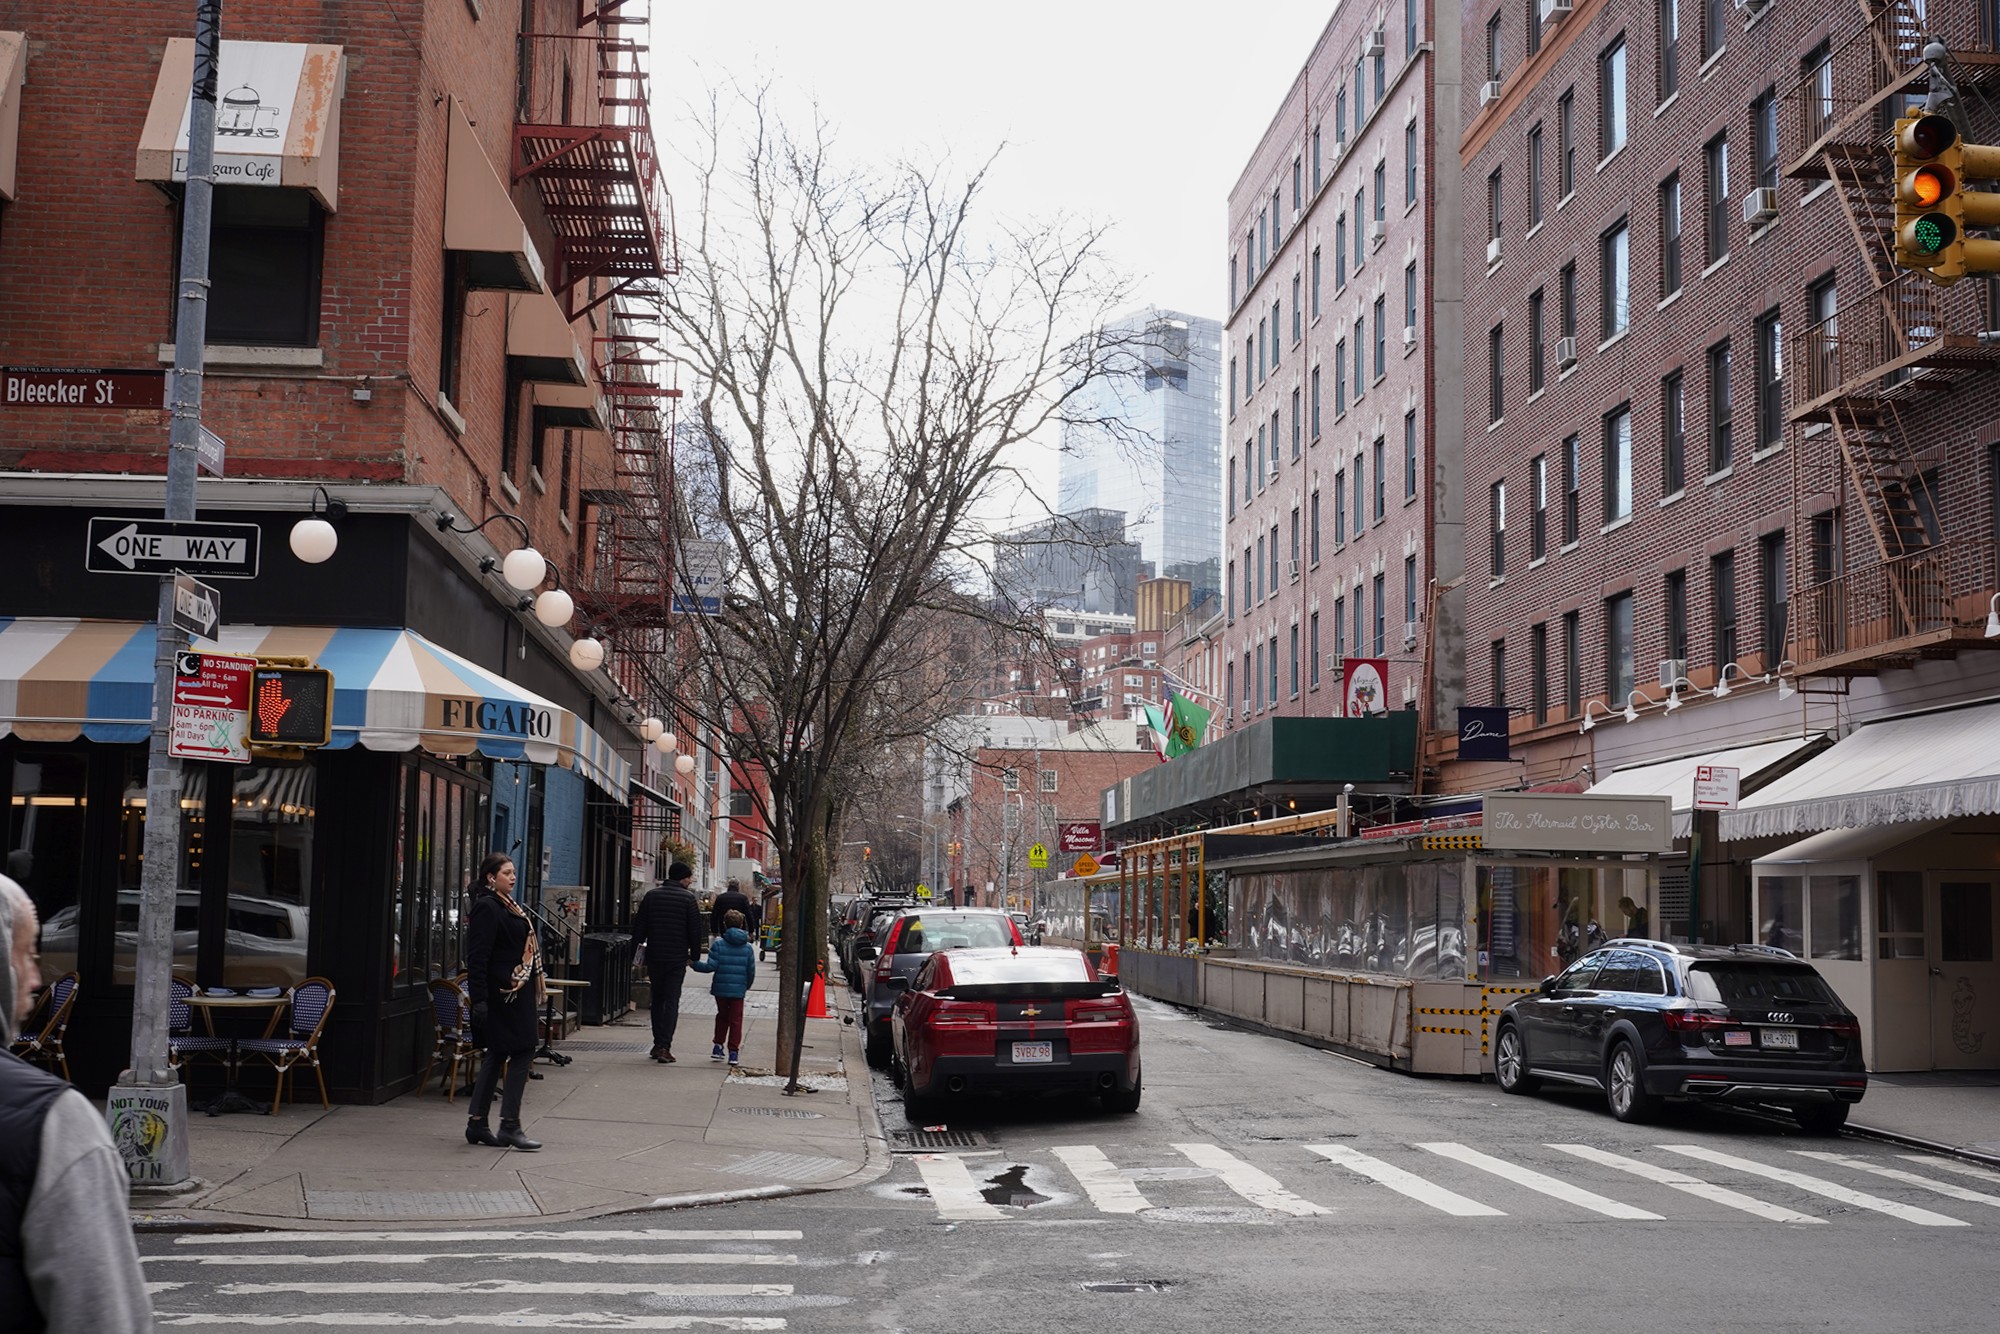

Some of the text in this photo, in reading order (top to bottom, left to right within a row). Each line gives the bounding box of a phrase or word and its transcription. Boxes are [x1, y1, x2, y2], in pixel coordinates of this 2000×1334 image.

[174, 158, 275, 181] L garo Cafe
[7, 377, 114, 404] Bleecker St
[115, 536, 236, 560] ONE WAY
[178, 590, 213, 624] ONE WAY
[203, 659, 254, 672] NO STANDING
[202, 671, 217, 680] 6pm
[223, 673, 238, 682] 6am
[201, 680, 211, 688] All
[212, 681, 229, 690] Days
[176, 707, 235, 722] NO PARKING
[441, 699, 552, 738] FIGARO
[175, 721, 192, 729] 6am
[199, 723, 215, 732] 6pm
[1461, 720, 1507, 741] Dame
[175, 730, 205, 741] All Days
[1495, 812, 1655, 834] The Mermaid Oyster Bar
[1071, 826, 1090, 834] Villa
[1065, 835, 1096, 843] Mosconi
[1480, 952, 1488, 962] A
[1780, 1034, 1795, 1044] 3921
[1015, 1046, 1051, 1058] 3VBZ 98
[110, 1097, 170, 1112] NOT YOUR
